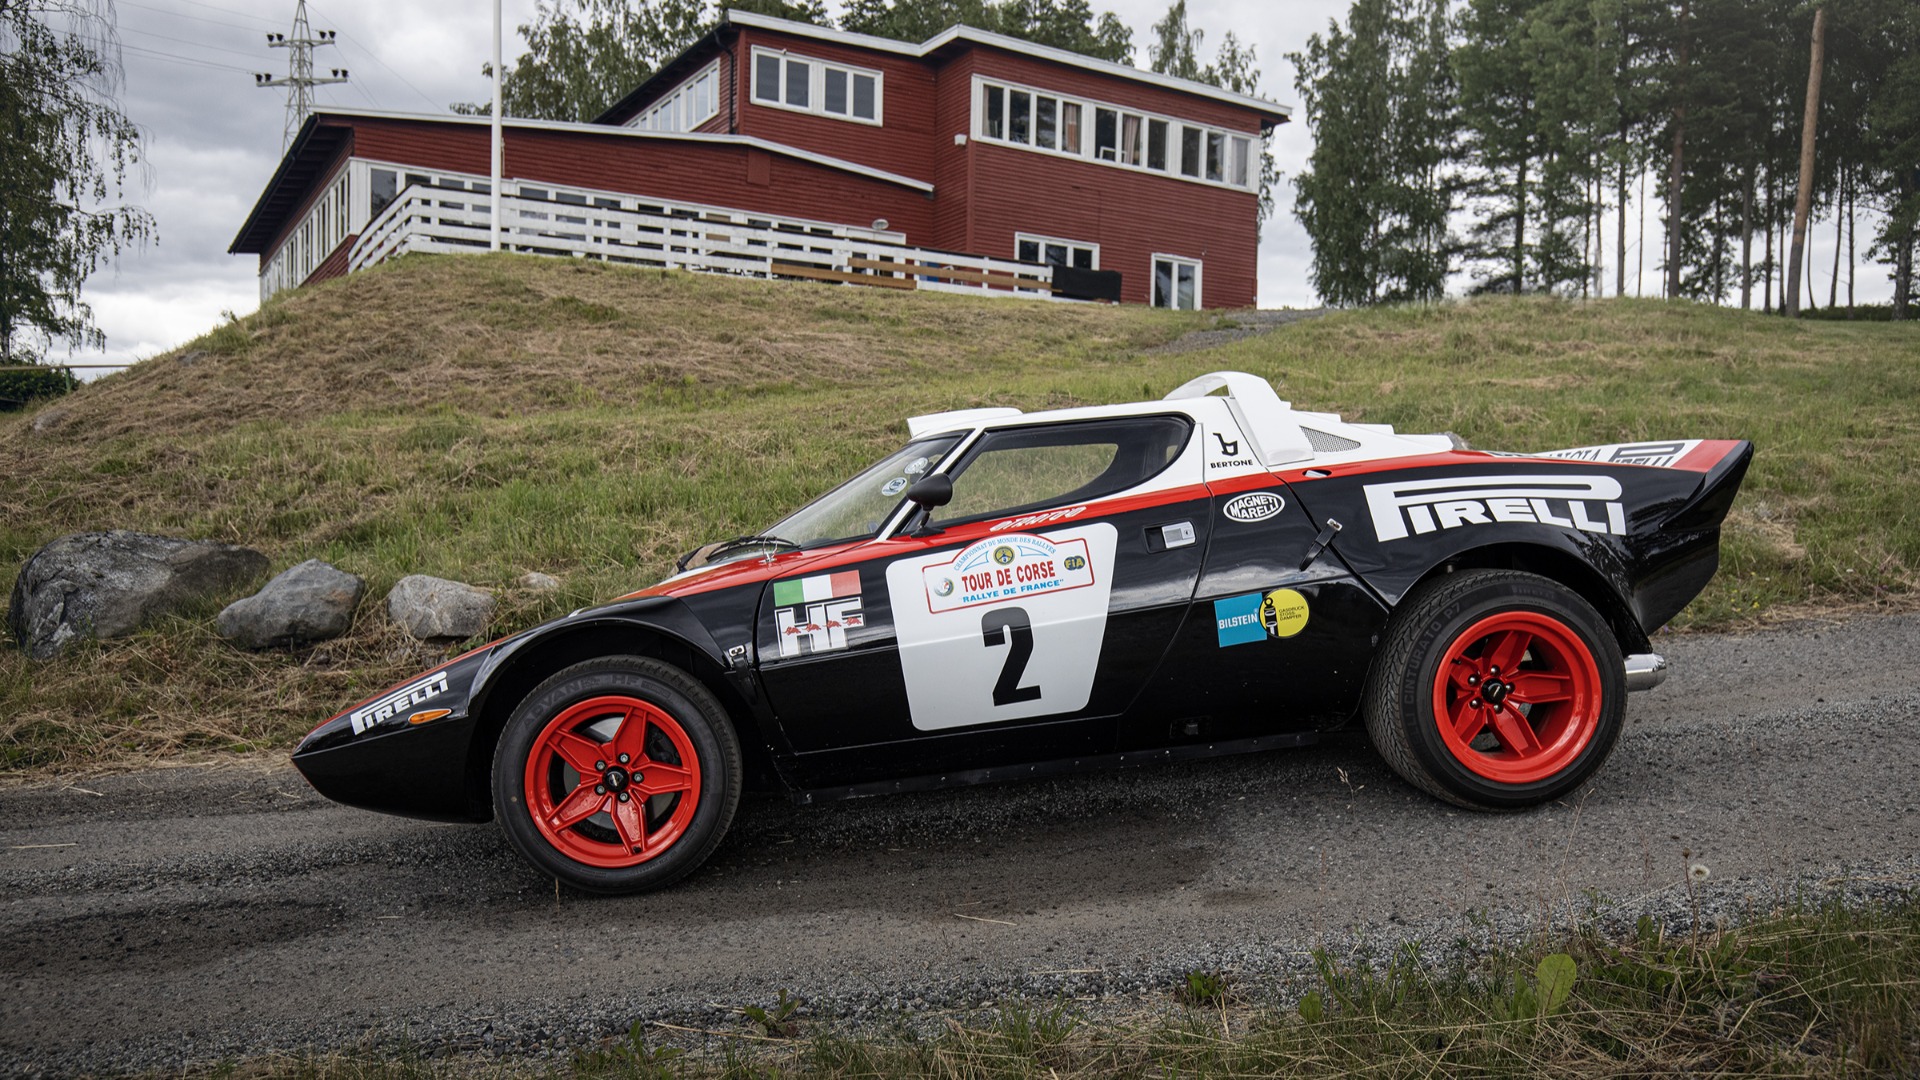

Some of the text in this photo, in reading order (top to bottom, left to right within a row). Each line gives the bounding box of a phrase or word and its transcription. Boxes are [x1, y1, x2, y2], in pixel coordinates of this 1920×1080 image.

[1210, 459, 1253, 469] BERTONE
[1608, 443, 1685, 467] PELLI
[1230, 496, 1278, 512] MAGNETI
[1230, 503, 1278, 518] MARELLI
[1363, 475, 1627, 542] PIRELLI
[954, 542, 988, 571] CHAMPIONNAT
[1032, 538, 1056, 554] RALLYES
[1064, 559, 1085, 570] FIA
[961, 560, 1056, 593] TOUR DE CORSE
[962, 590, 999, 603] RALLYE
[1003, 587, 1017, 596] DE
[774, 596, 865, 658] HF
[1218, 613, 1258, 629] BILSTEIN
[981, 607, 1042, 707] 2
[1404, 621, 1443, 705] CINTURATO
[1443, 602, 1461, 619] P7
[350, 671, 449, 736] PIRELLI
[525, 680, 581, 728] ADVAN
